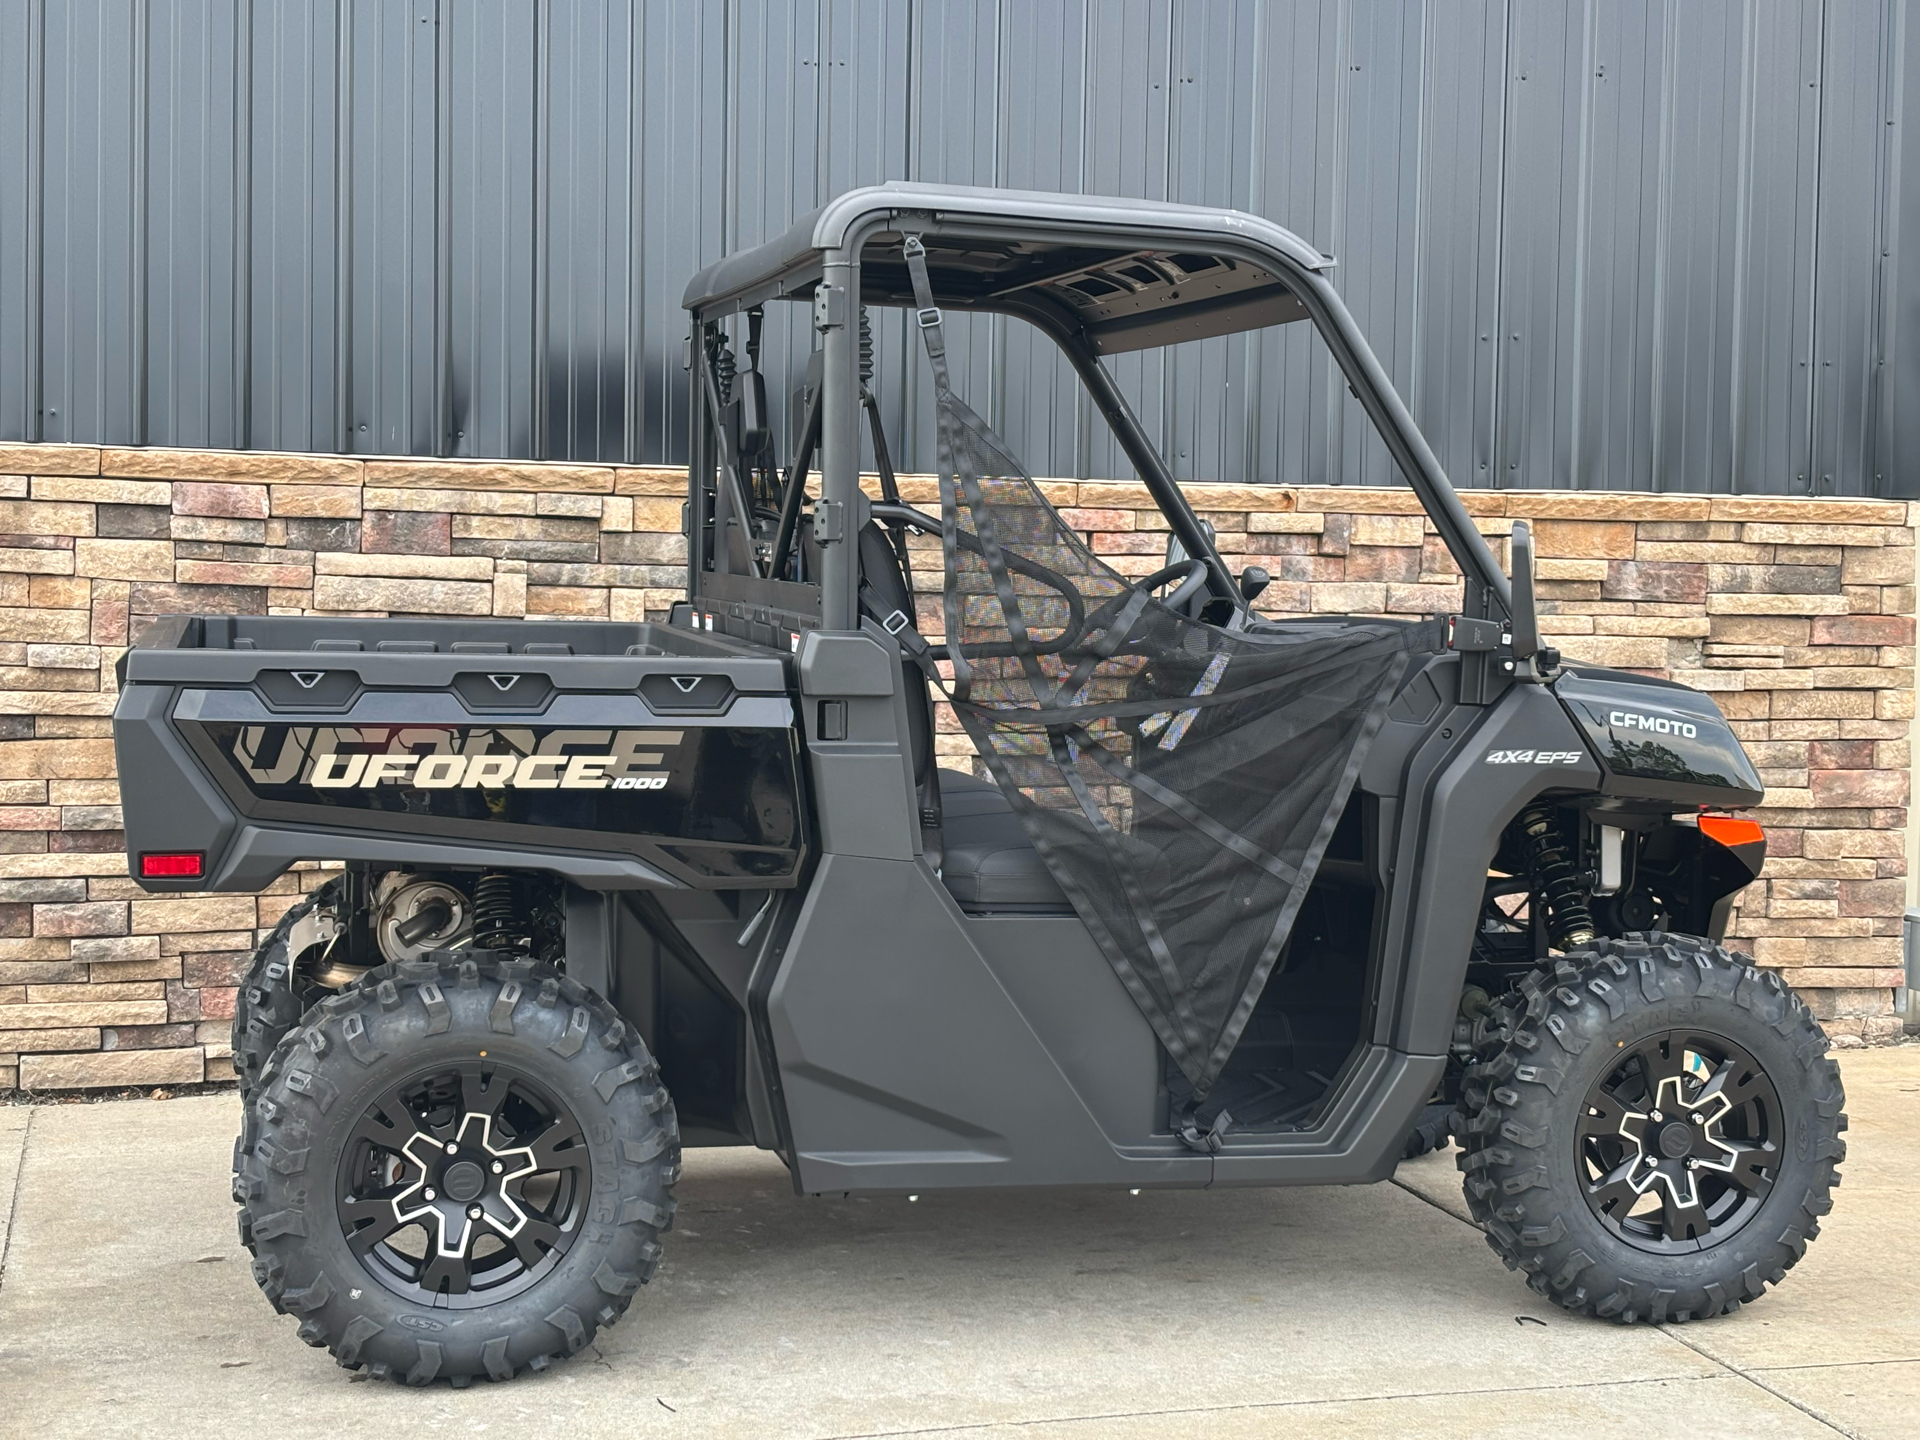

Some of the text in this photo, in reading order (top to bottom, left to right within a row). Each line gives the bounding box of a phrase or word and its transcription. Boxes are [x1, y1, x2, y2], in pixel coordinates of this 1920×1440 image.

[1609, 711, 1697, 739] CFMOTO
[310, 754, 669, 789] UFORCE 1000
